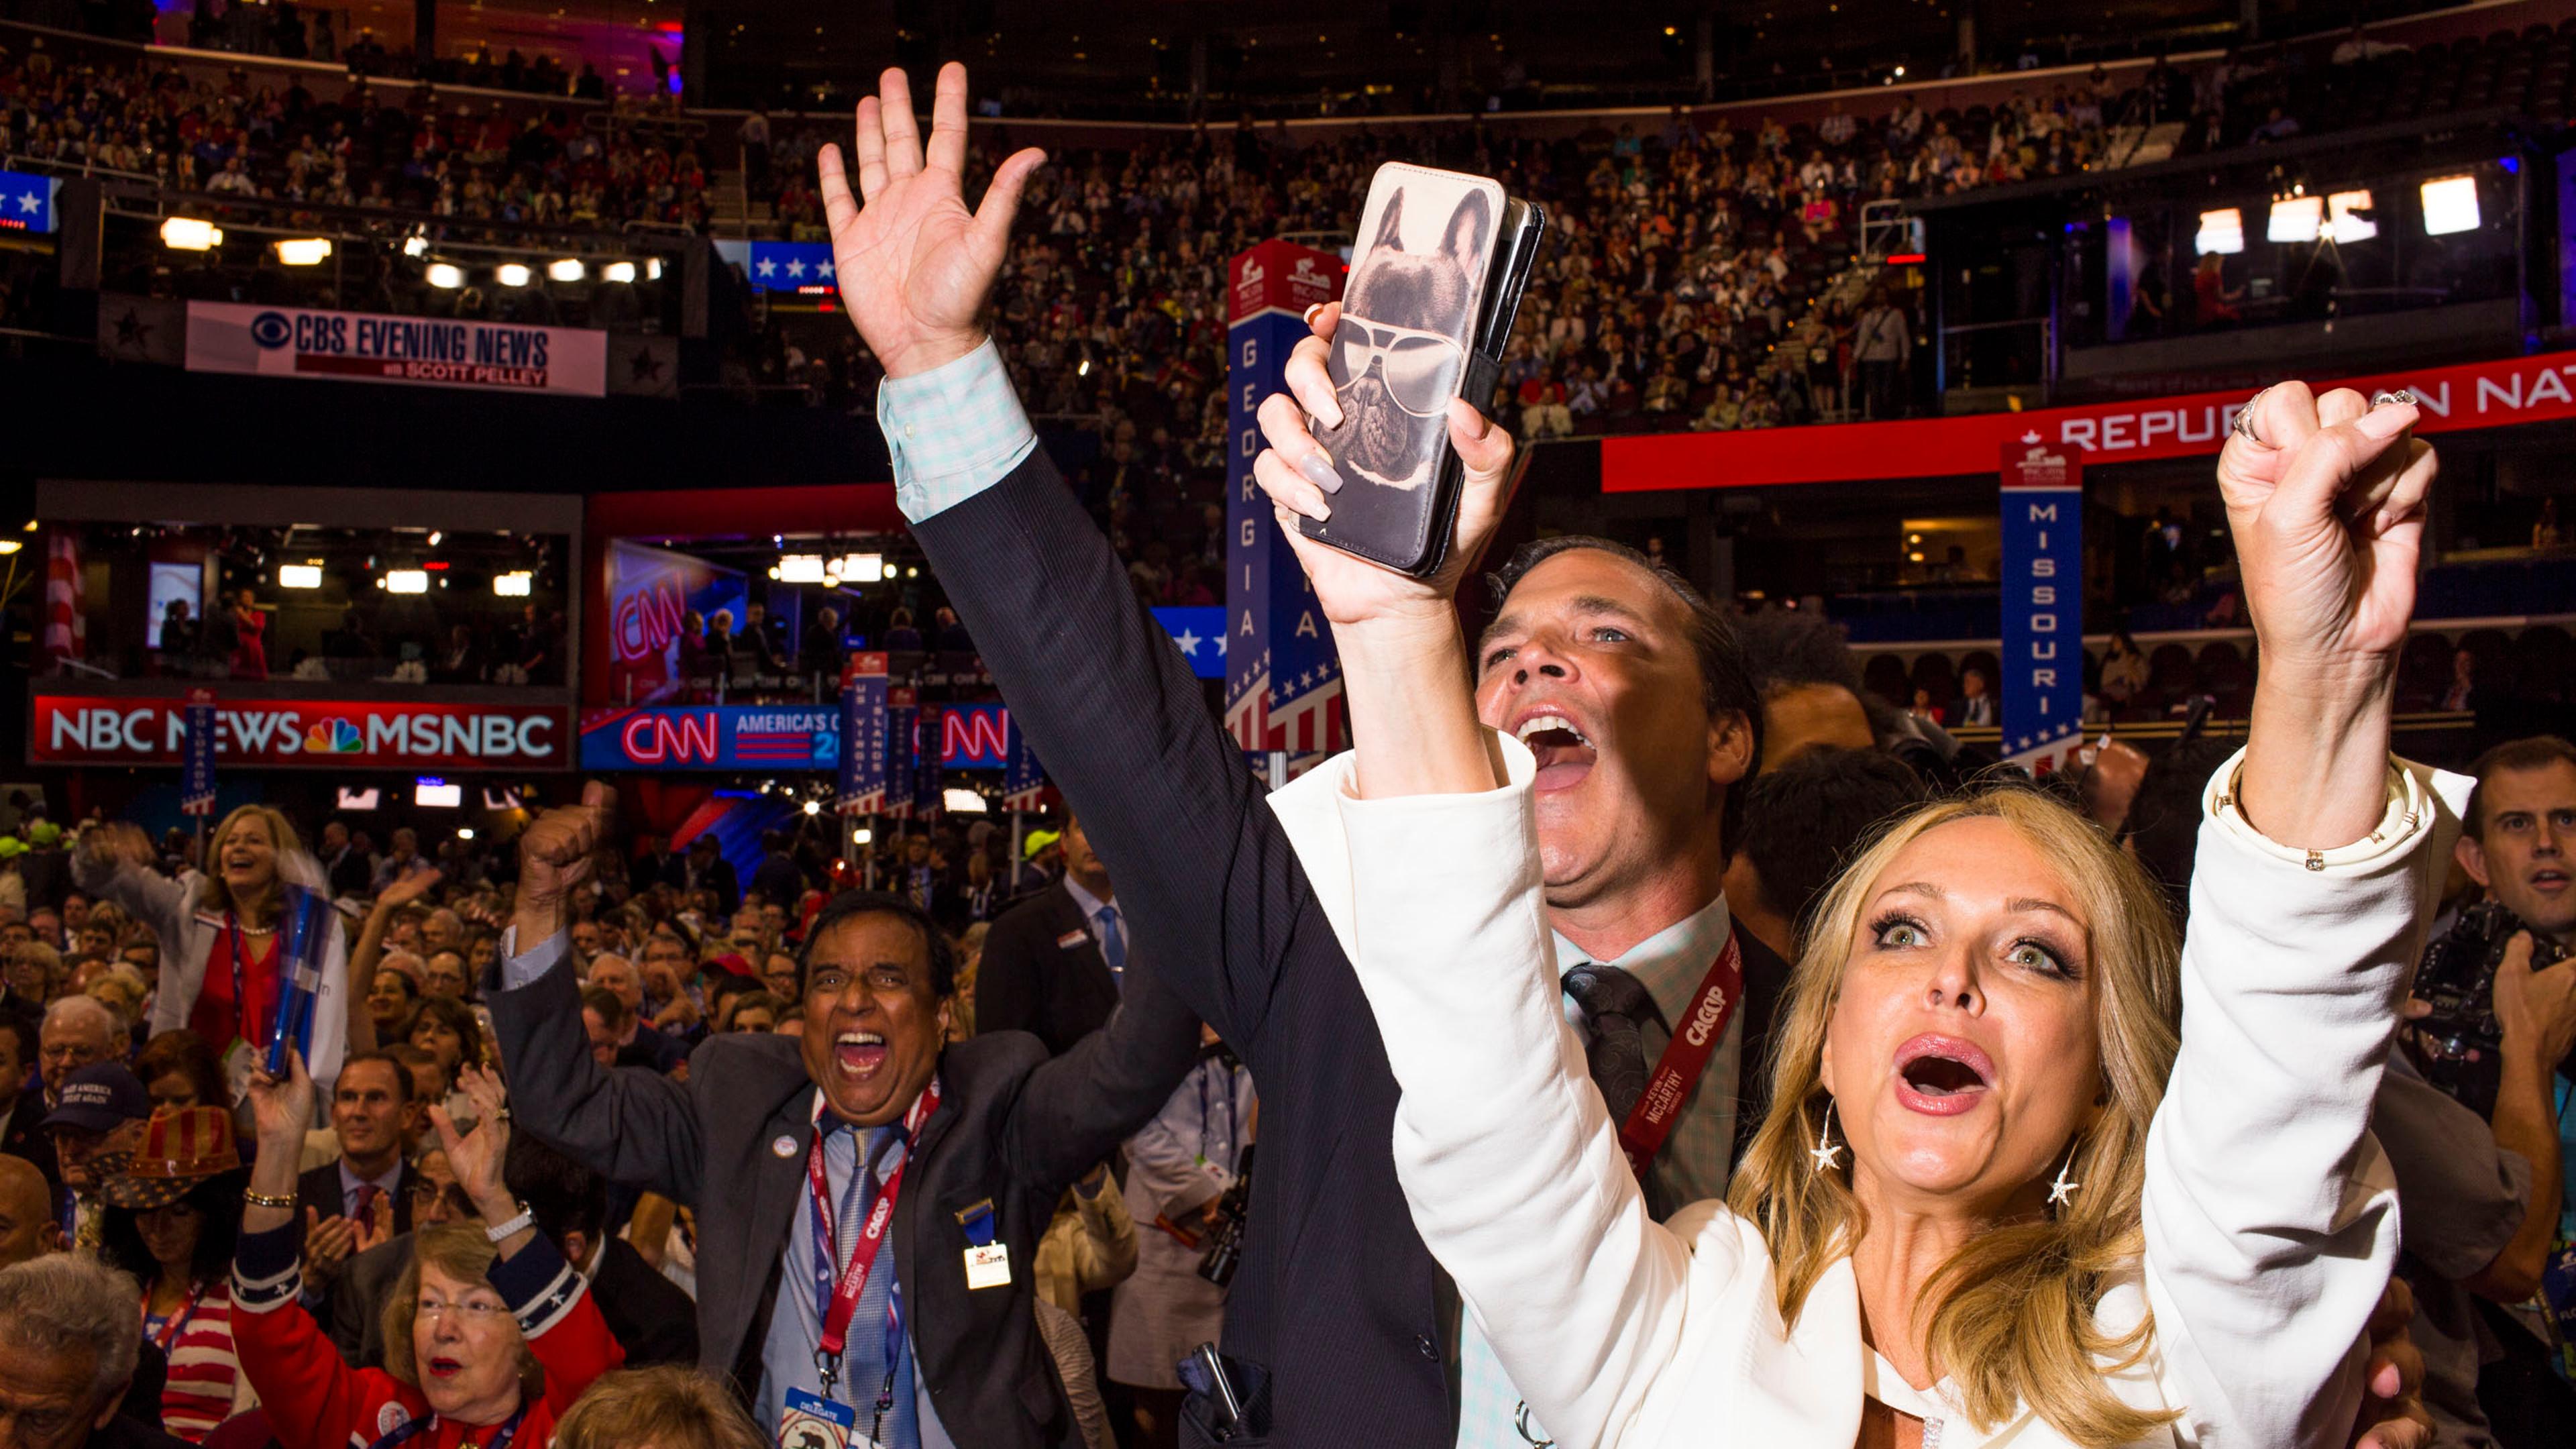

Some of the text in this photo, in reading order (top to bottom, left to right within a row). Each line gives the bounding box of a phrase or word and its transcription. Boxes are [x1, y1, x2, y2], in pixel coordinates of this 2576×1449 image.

[295, 313, 549, 369] CBS EVENING NEWS
[406, 364, 468, 382] SCOTT
[474, 366, 545, 386] PELLEY
[1240, 338, 1258, 637] GEORGIA
[616, 572, 687, 660] CNN
[2029, 503, 2057, 716] MISSOURI
[51, 708, 154, 752] NBC
[366, 712, 554, 757] MSNBC
[621, 711, 720, 764] CNN
[735, 712, 827, 733] AMERICA'S
[913, 708, 1009, 763] NN
[1685, 985, 1727, 1047] CAGOP
[799, 1401, 839, 1421] DELEGATE
